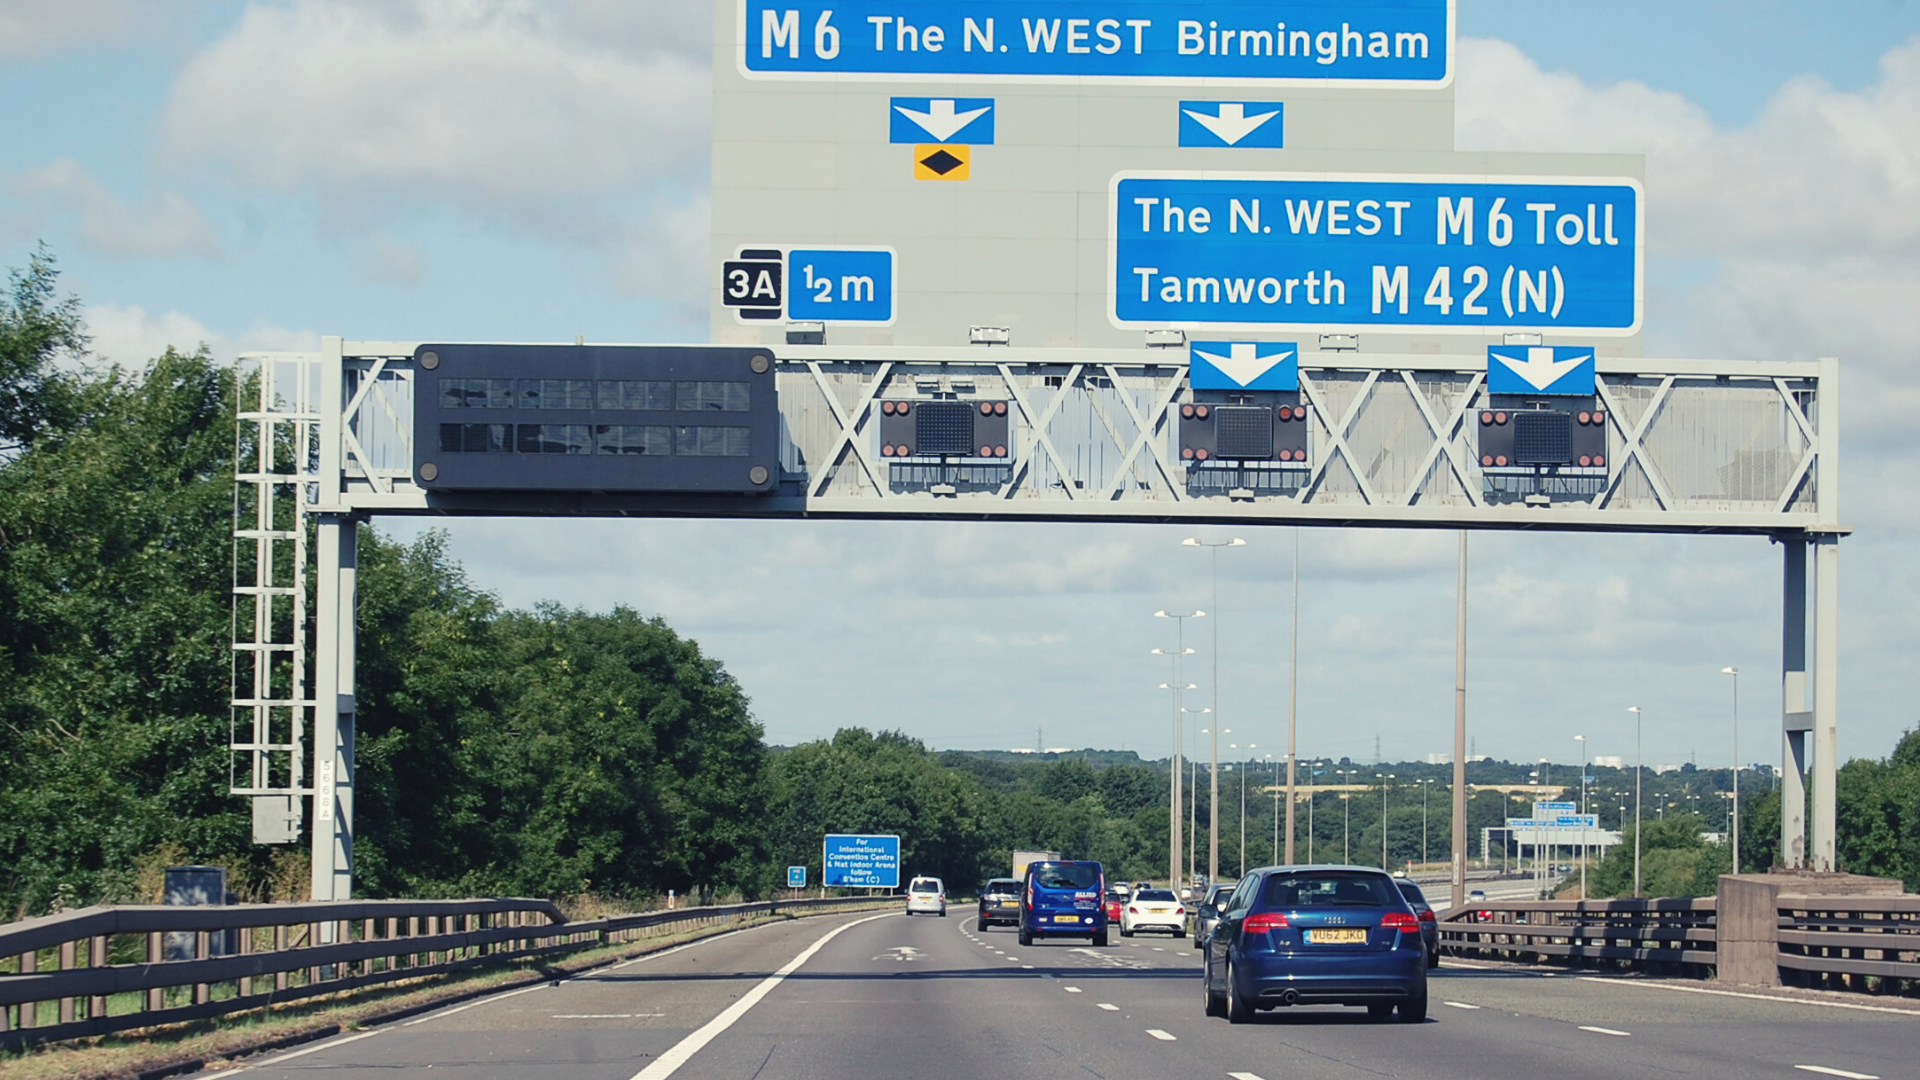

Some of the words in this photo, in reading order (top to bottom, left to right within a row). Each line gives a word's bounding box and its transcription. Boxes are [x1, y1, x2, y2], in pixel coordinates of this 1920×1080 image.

[867, 16, 945, 52] The
[963, 17, 1008, 53] N.
[1021, 18, 1152, 54] WEST
[1178, 20, 1429, 65] Birmingham
[1134, 197, 1211, 234] The
[1229, 198, 1271, 234] N.
[1284, 199, 1411, 236] WEST
[1526, 203, 1619, 246] Toll
[728, 269, 776, 299] 3A
[1134, 267, 1345, 306] Tamworth
[866, 876, 880, 884] (C)
[875, 861, 896, 869] Arena
[1312, 929, 1340, 940] VU62
